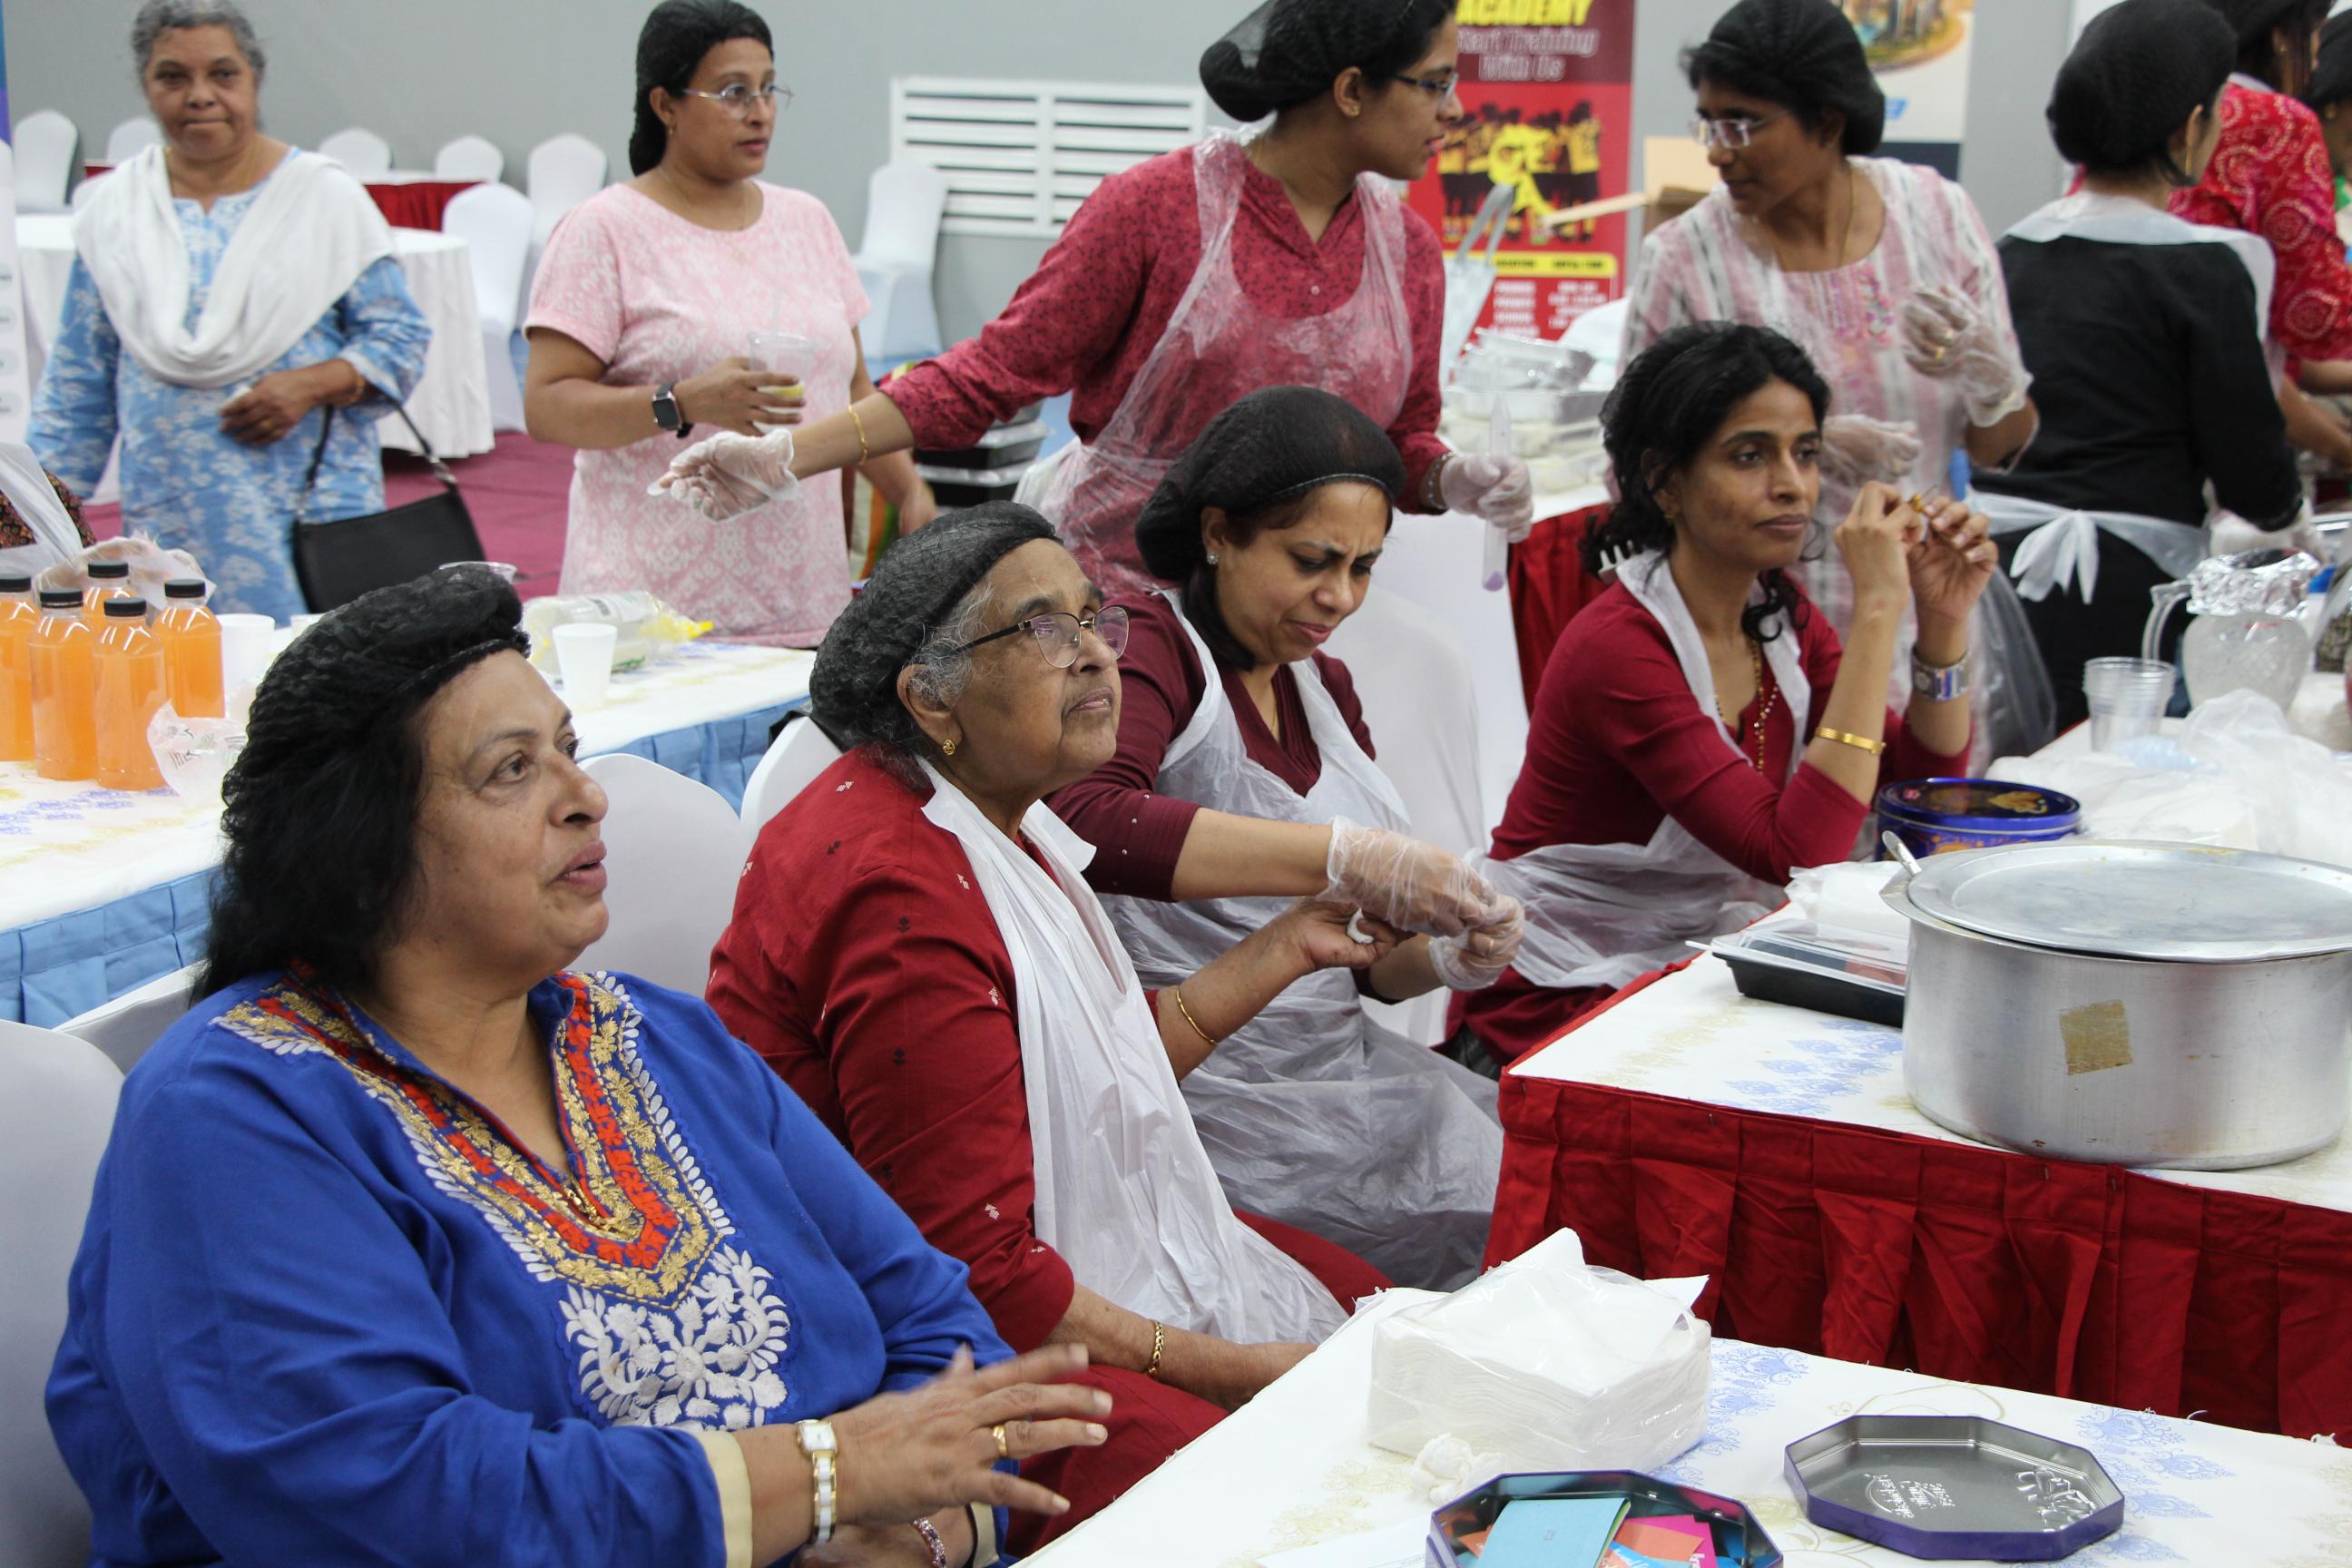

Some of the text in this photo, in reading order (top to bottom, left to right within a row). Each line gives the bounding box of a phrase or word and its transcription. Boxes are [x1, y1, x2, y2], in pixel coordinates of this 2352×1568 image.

[1455, 0, 1593, 26] ACADEMY
[1502, 28, 1600, 57] Training
[1479, 54, 1566, 81] With Us
